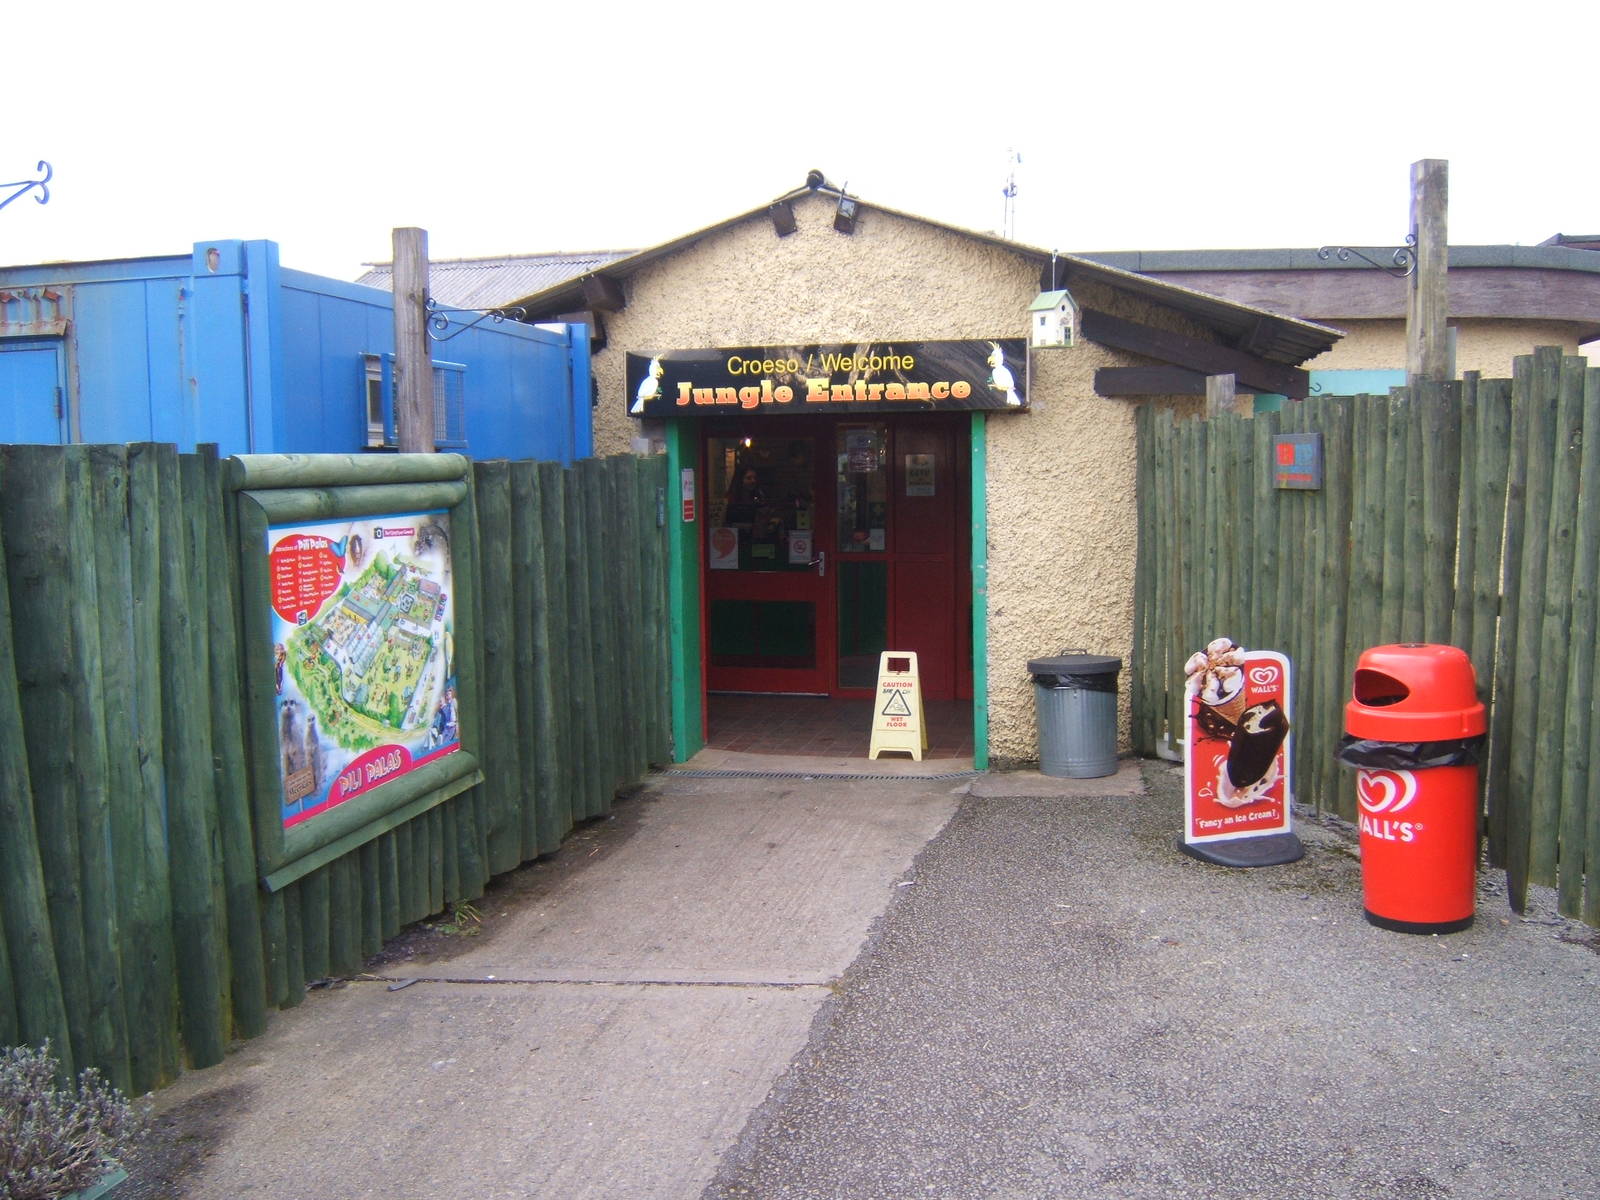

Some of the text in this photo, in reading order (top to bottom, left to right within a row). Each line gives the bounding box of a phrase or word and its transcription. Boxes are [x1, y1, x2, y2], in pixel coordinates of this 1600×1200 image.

[727, 352, 914, 375] Croeso / Welcome
[676, 378, 972, 409] Jungle Entrance
[1251, 685, 1276, 694] WALL'S
[339, 767, 363, 796] PILI
[365, 749, 402, 783] PALAS
[1200, 809, 1276, 829] Fancy an Ice Cream?
